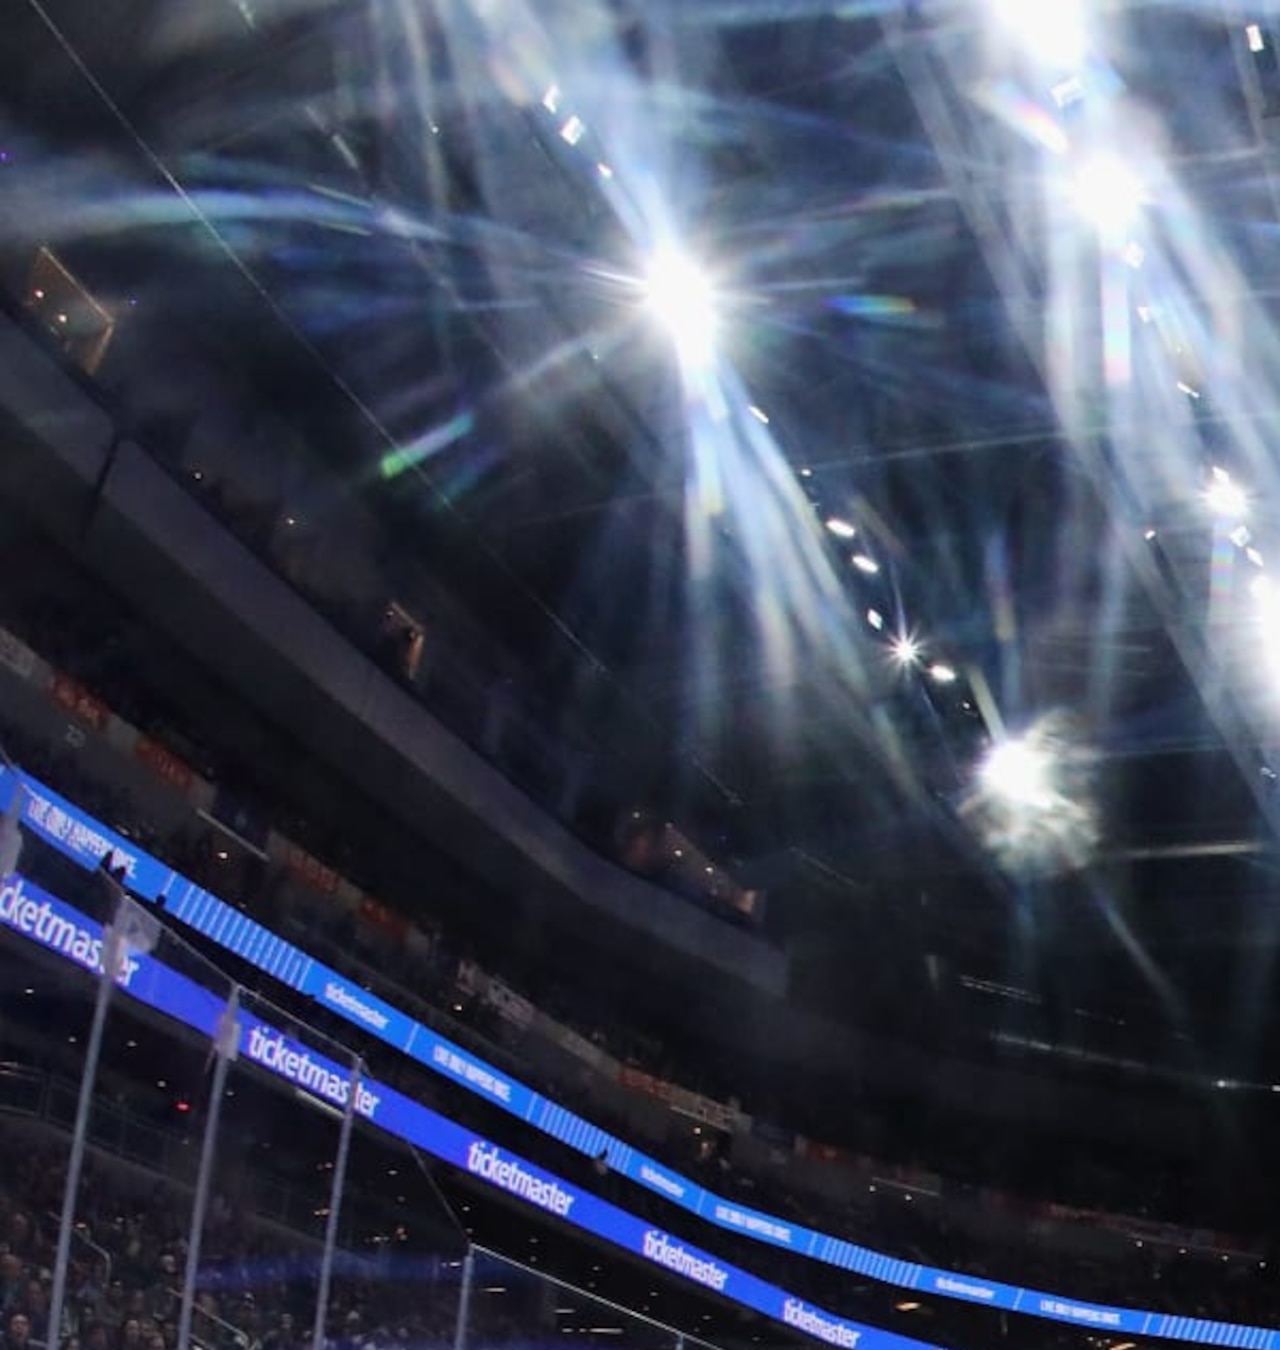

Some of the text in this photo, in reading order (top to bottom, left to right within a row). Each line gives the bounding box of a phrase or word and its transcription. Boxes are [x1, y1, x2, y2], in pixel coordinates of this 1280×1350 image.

[250, 1025, 381, 1119] ticketmaster
[469, 1141, 575, 1217] ticketmaster
[642, 1229, 728, 1290] ticketmaster
[783, 1297, 861, 1349] ticketmaster
